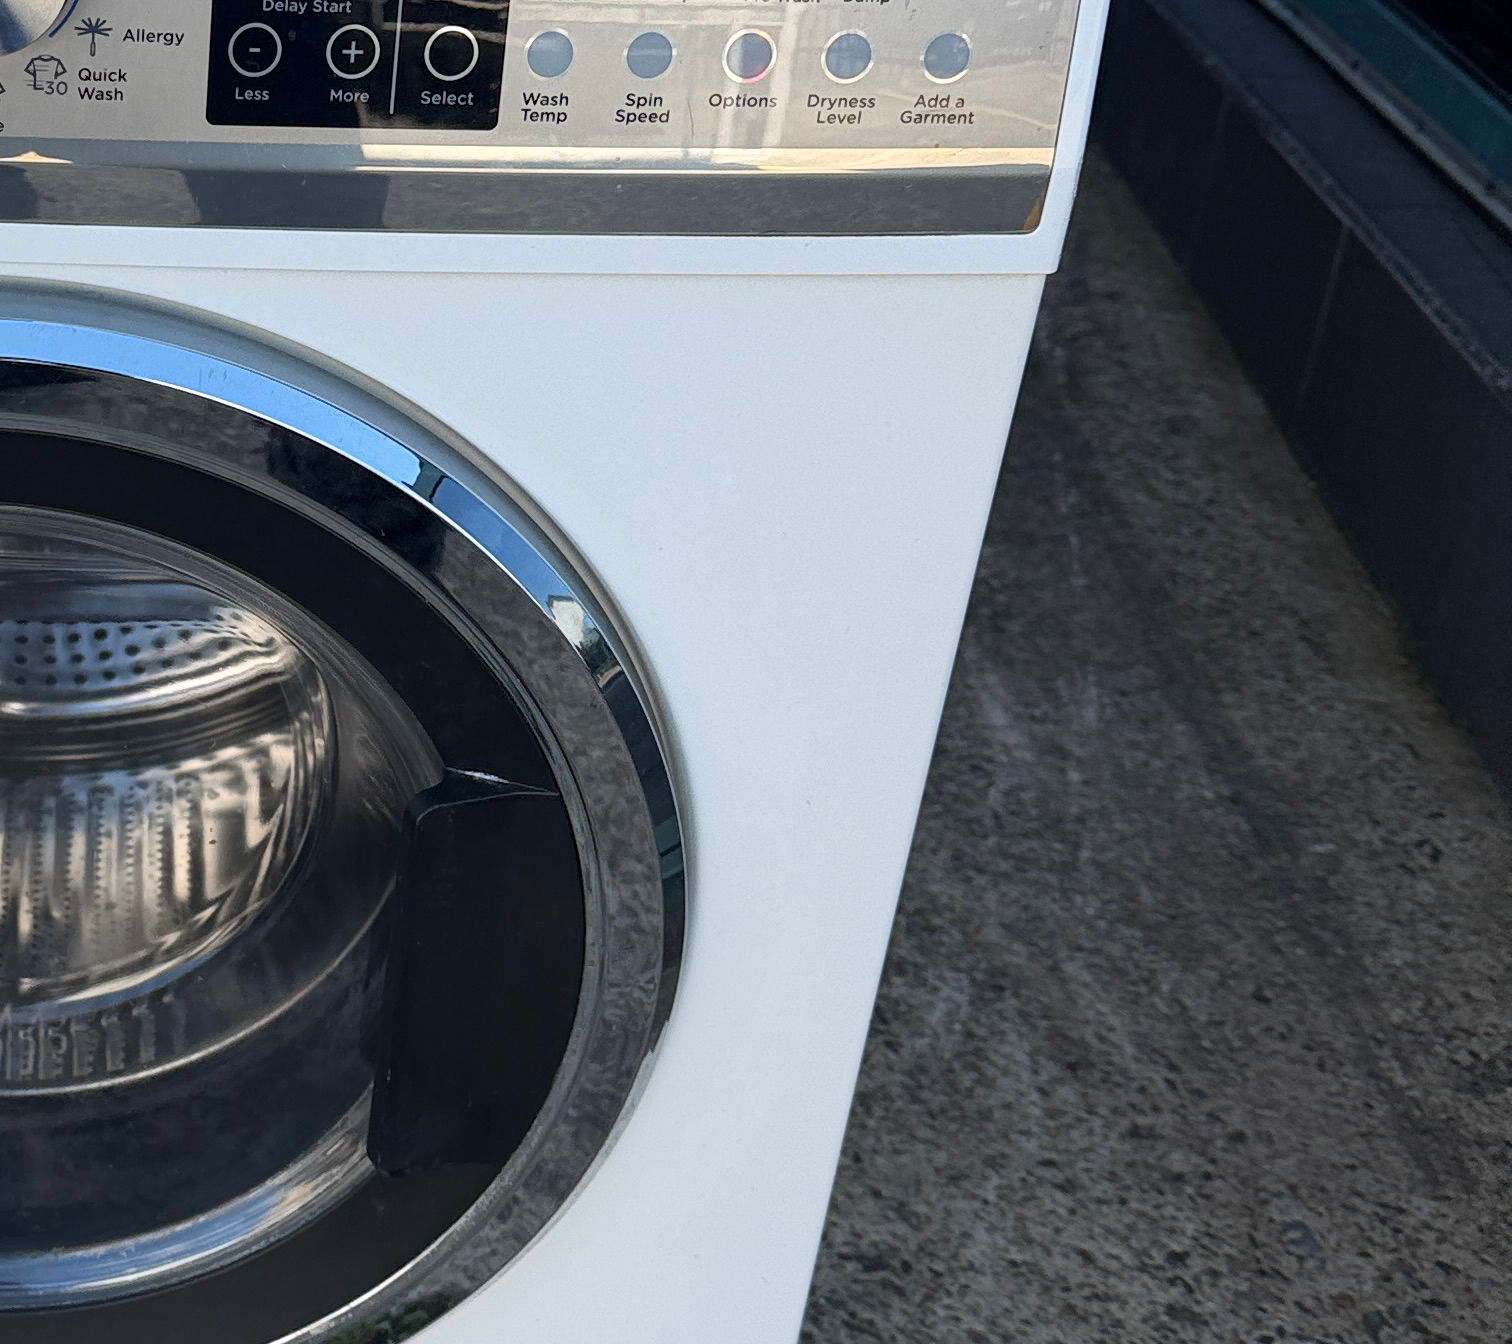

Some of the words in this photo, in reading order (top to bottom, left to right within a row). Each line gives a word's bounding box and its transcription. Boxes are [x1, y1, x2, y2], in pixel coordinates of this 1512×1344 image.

[262, 0, 307, 15] Delay
[312, 0, 352, 13] Start
[123, 28, 185, 47] Allergy
[78, 67, 128, 85] Quick
[43, 80, 68, 96] 30
[78, 87, 124, 102] Wash
[235, 87, 270, 101] Less
[330, 89, 369, 103] More
[421, 91, 474, 106] Select
[522, 92, 569, 108] Wash
[625, 93, 663, 112] Spin
[708, 93, 778, 112] Options
[807, 94, 876, 112] Dryness
[914, 94, 950, 110] Add
[955, 97, 965, 110] a
[521, 109, 568, 127] Temp
[614, 108, 670, 127] Speed
[816, 109, 862, 125] Level
[899, 109, 975, 125] Garment
